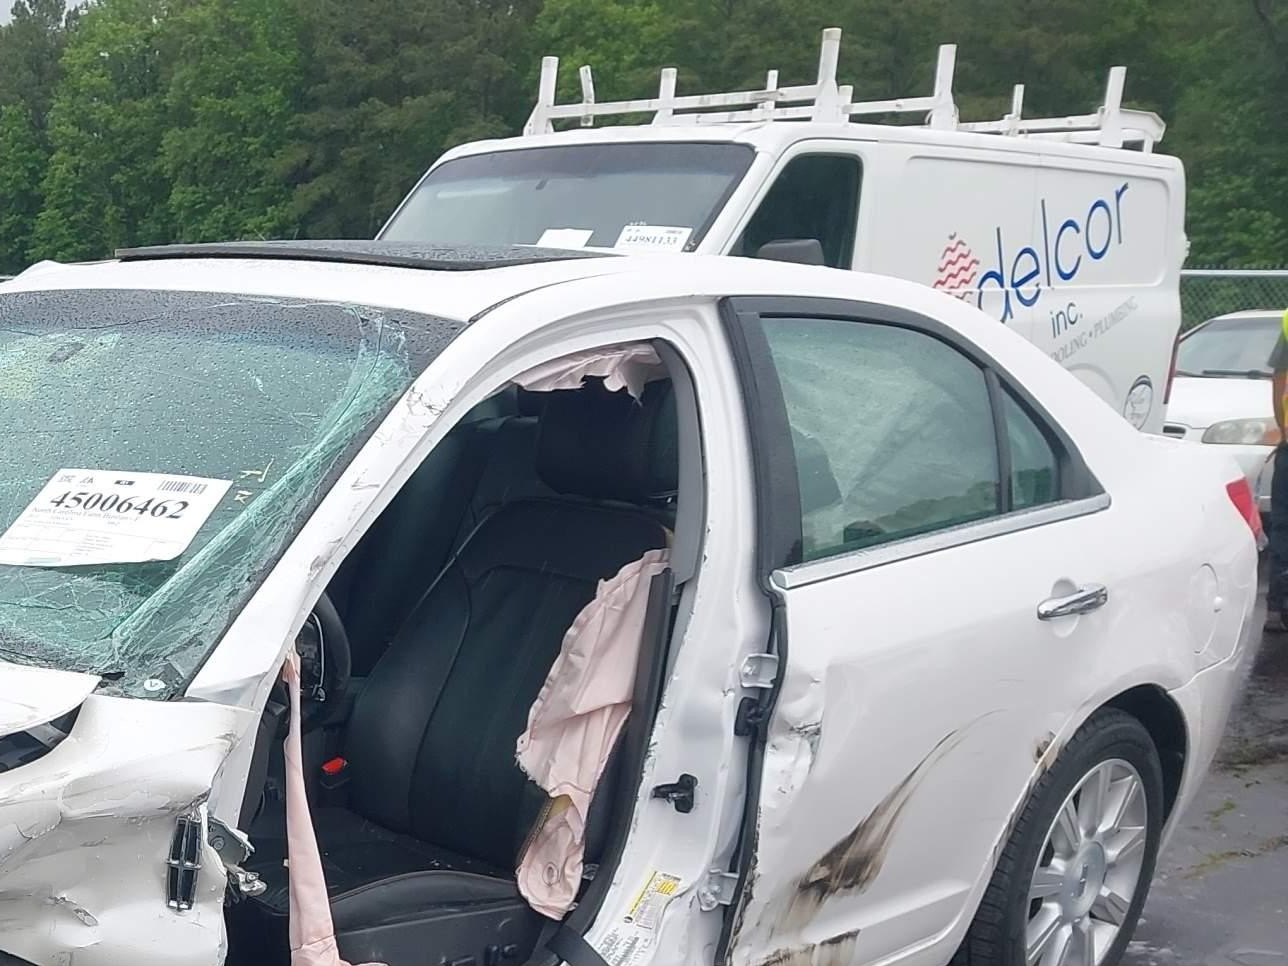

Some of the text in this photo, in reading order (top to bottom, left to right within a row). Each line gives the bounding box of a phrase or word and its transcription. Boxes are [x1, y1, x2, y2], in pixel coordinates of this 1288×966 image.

[977, 182, 1129, 323] delcor
[1050, 302, 1083, 339] inc.
[50, 490, 189, 519] 45006462
